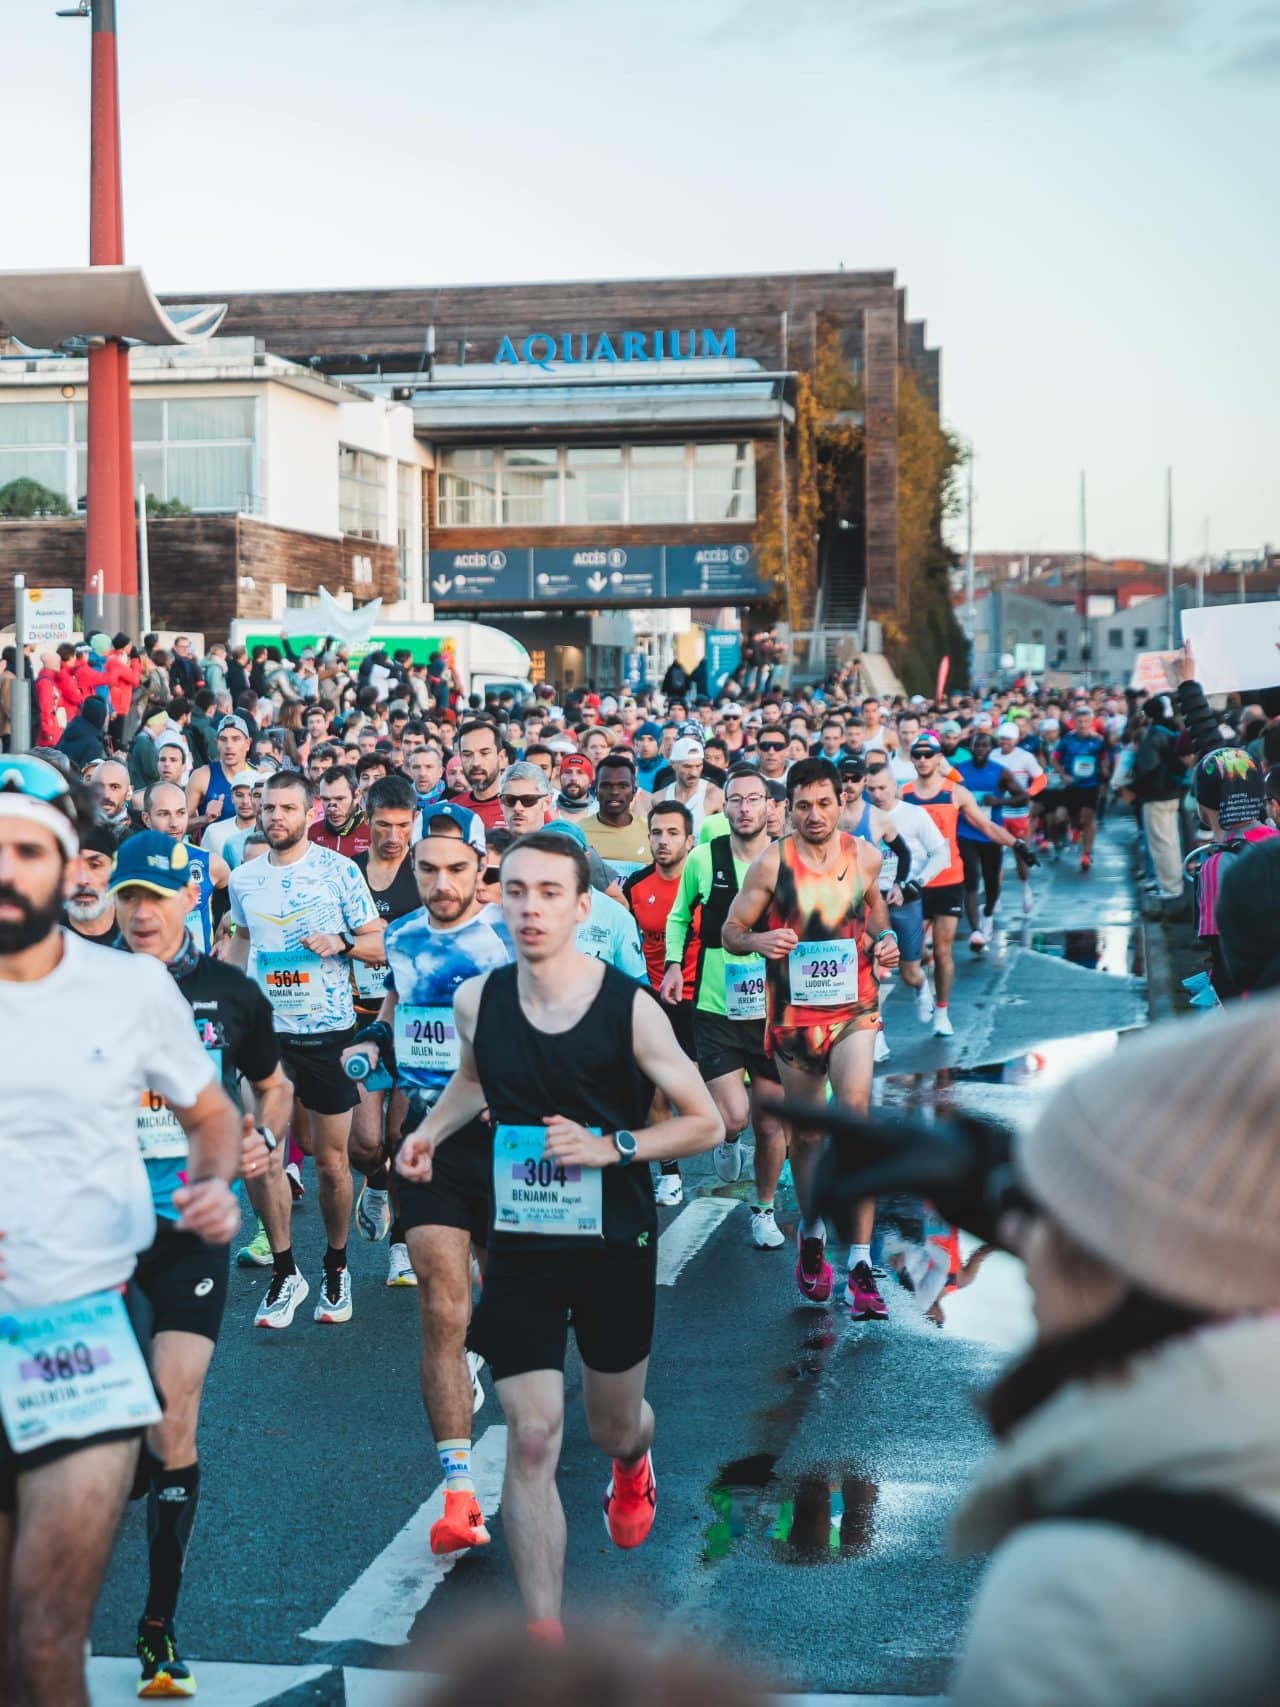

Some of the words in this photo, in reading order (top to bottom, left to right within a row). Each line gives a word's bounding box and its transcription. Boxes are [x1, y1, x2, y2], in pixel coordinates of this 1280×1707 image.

[493, 328, 736, 372] AQUARIUM
[811, 960, 838, 978] 233
[273, 970, 301, 987] 564
[741, 978, 764, 995] 429
[805, 980, 831, 988] LUDOVIC
[413, 1020, 445, 1044] 240
[411, 1046, 433, 1056] JULIEN
[524, 1158, 567, 1188] 304
[512, 1189, 558, 1204] BENJAMIN
[34, 1341, 95, 1382] 389
[18, 1386, 80, 1410] VALENTIN
